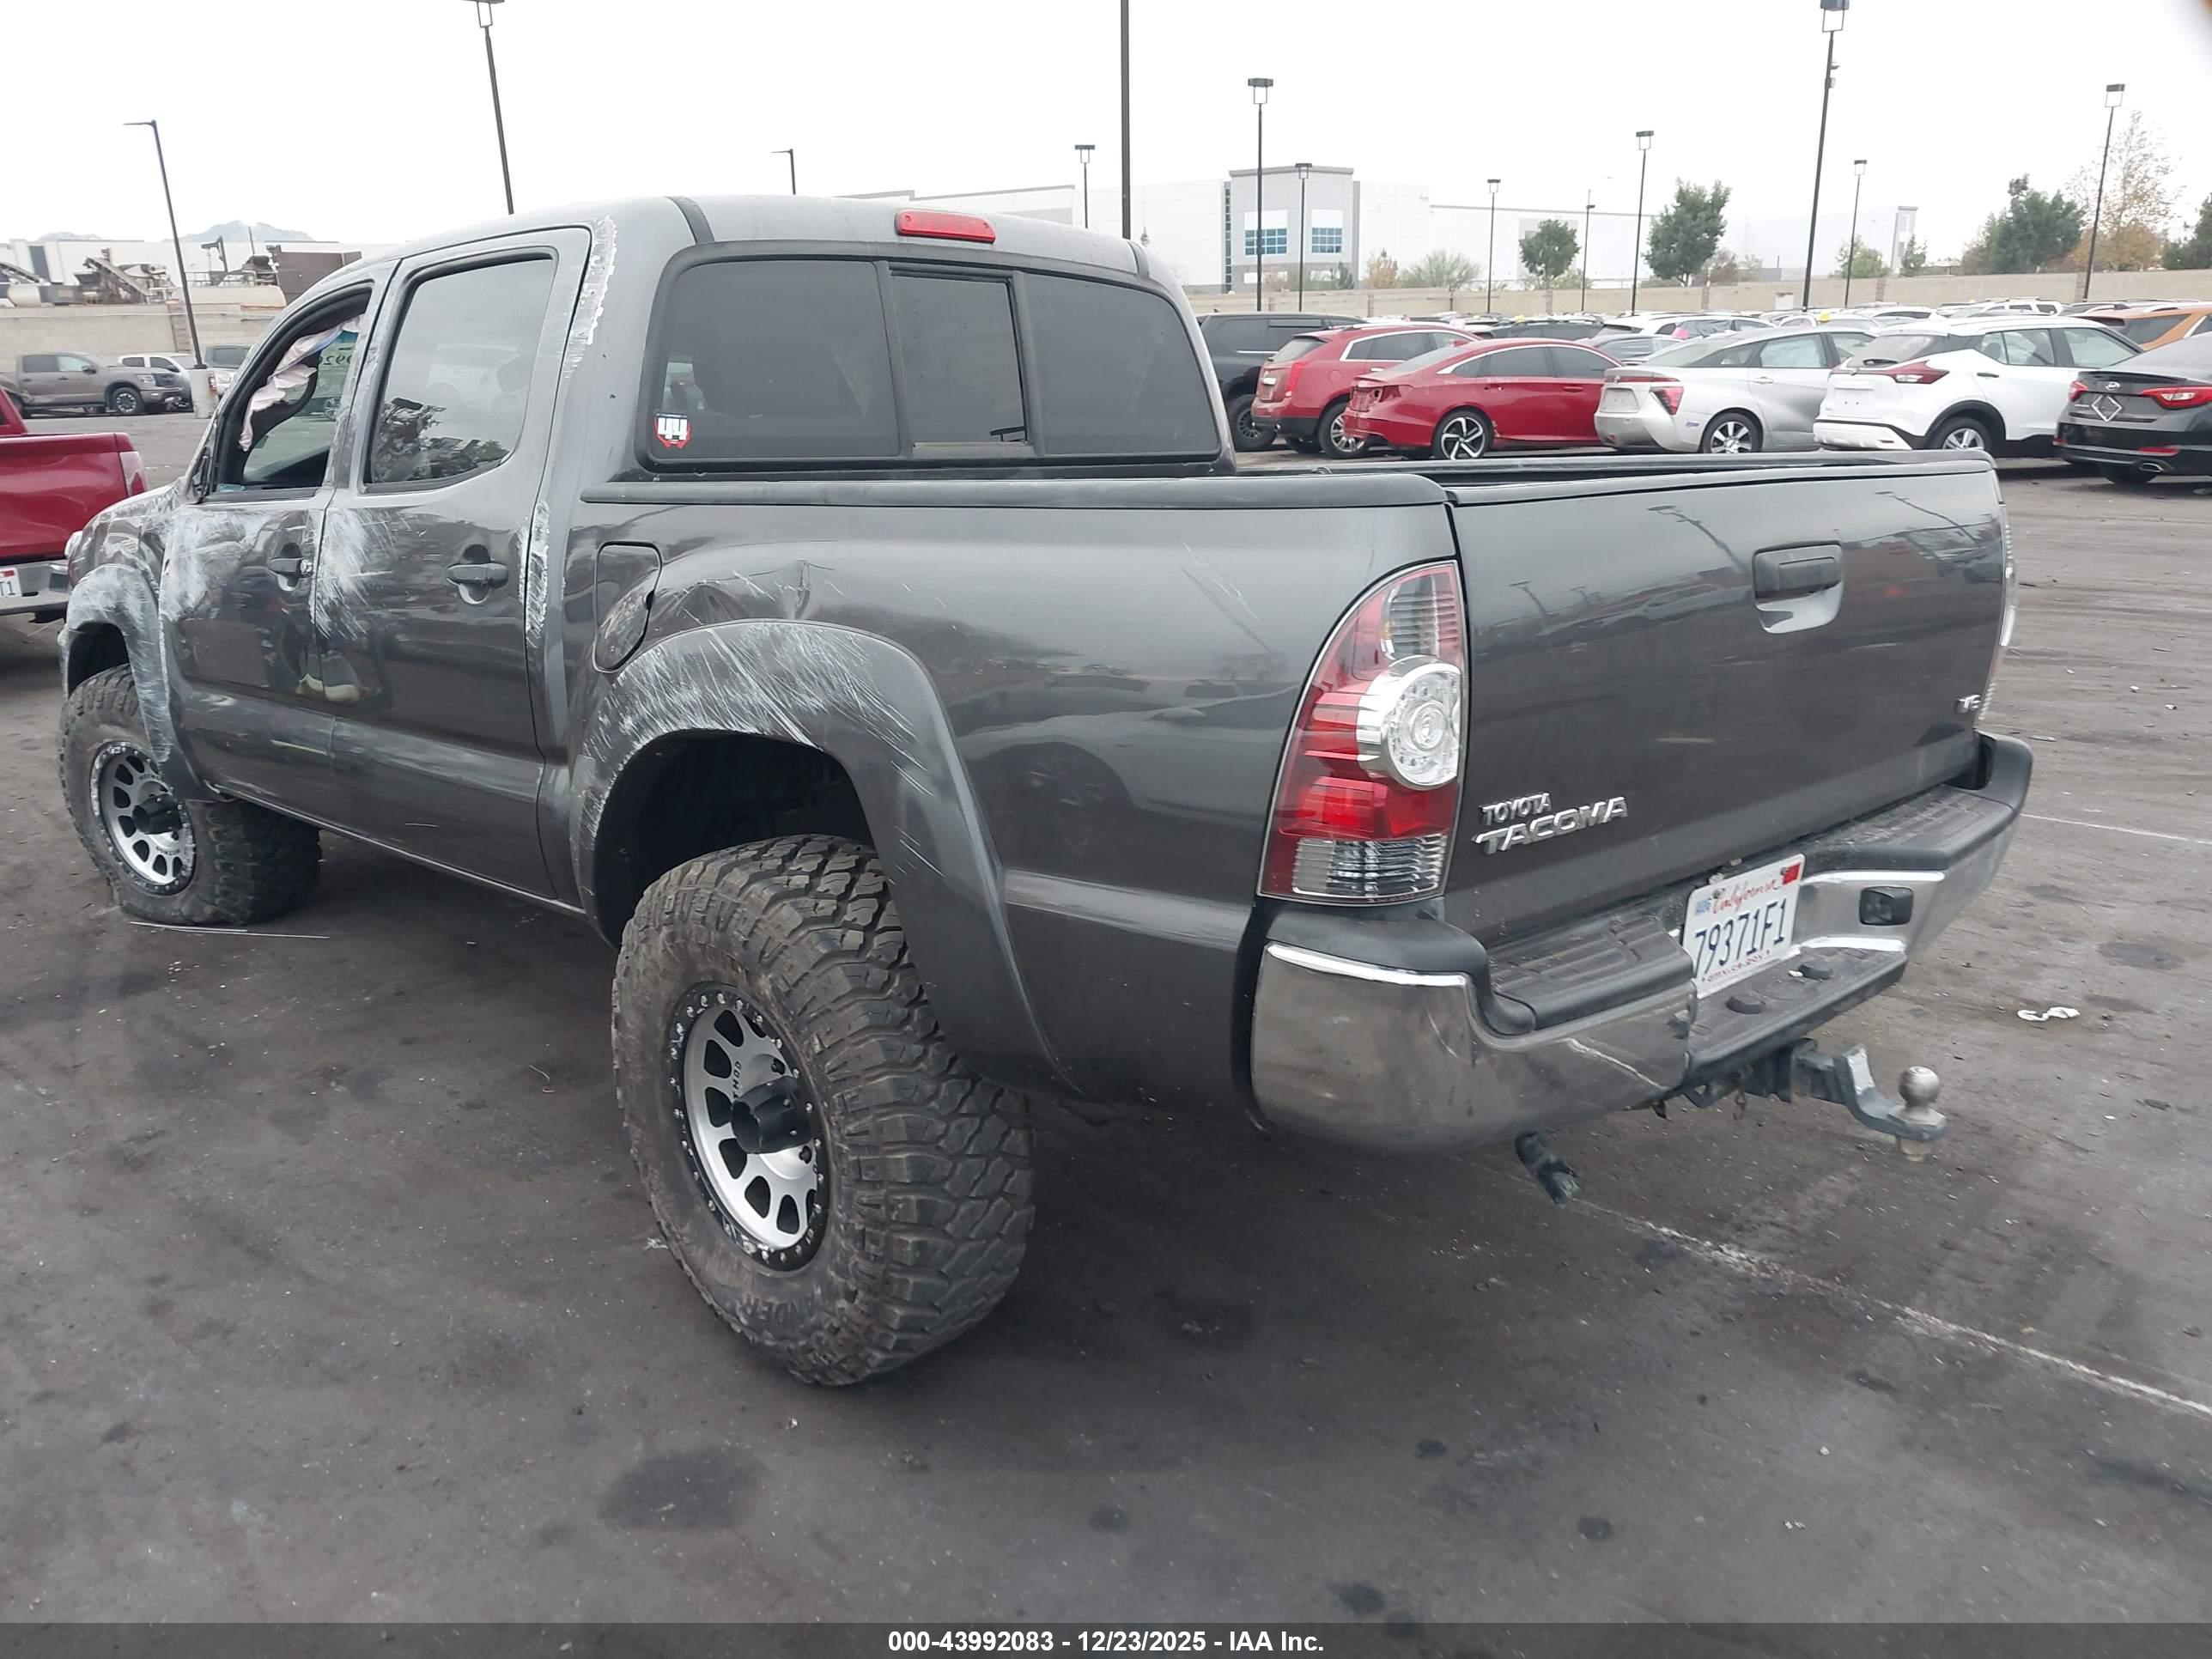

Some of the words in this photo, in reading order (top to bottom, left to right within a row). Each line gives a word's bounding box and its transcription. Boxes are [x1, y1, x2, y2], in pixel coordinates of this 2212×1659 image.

[1471, 797, 1628, 854] TACOMA
[1480, 793, 1553, 825] TOYOTA
[1695, 898, 1787, 977] 79371F1
[732, 1060, 742, 1099] THOD
